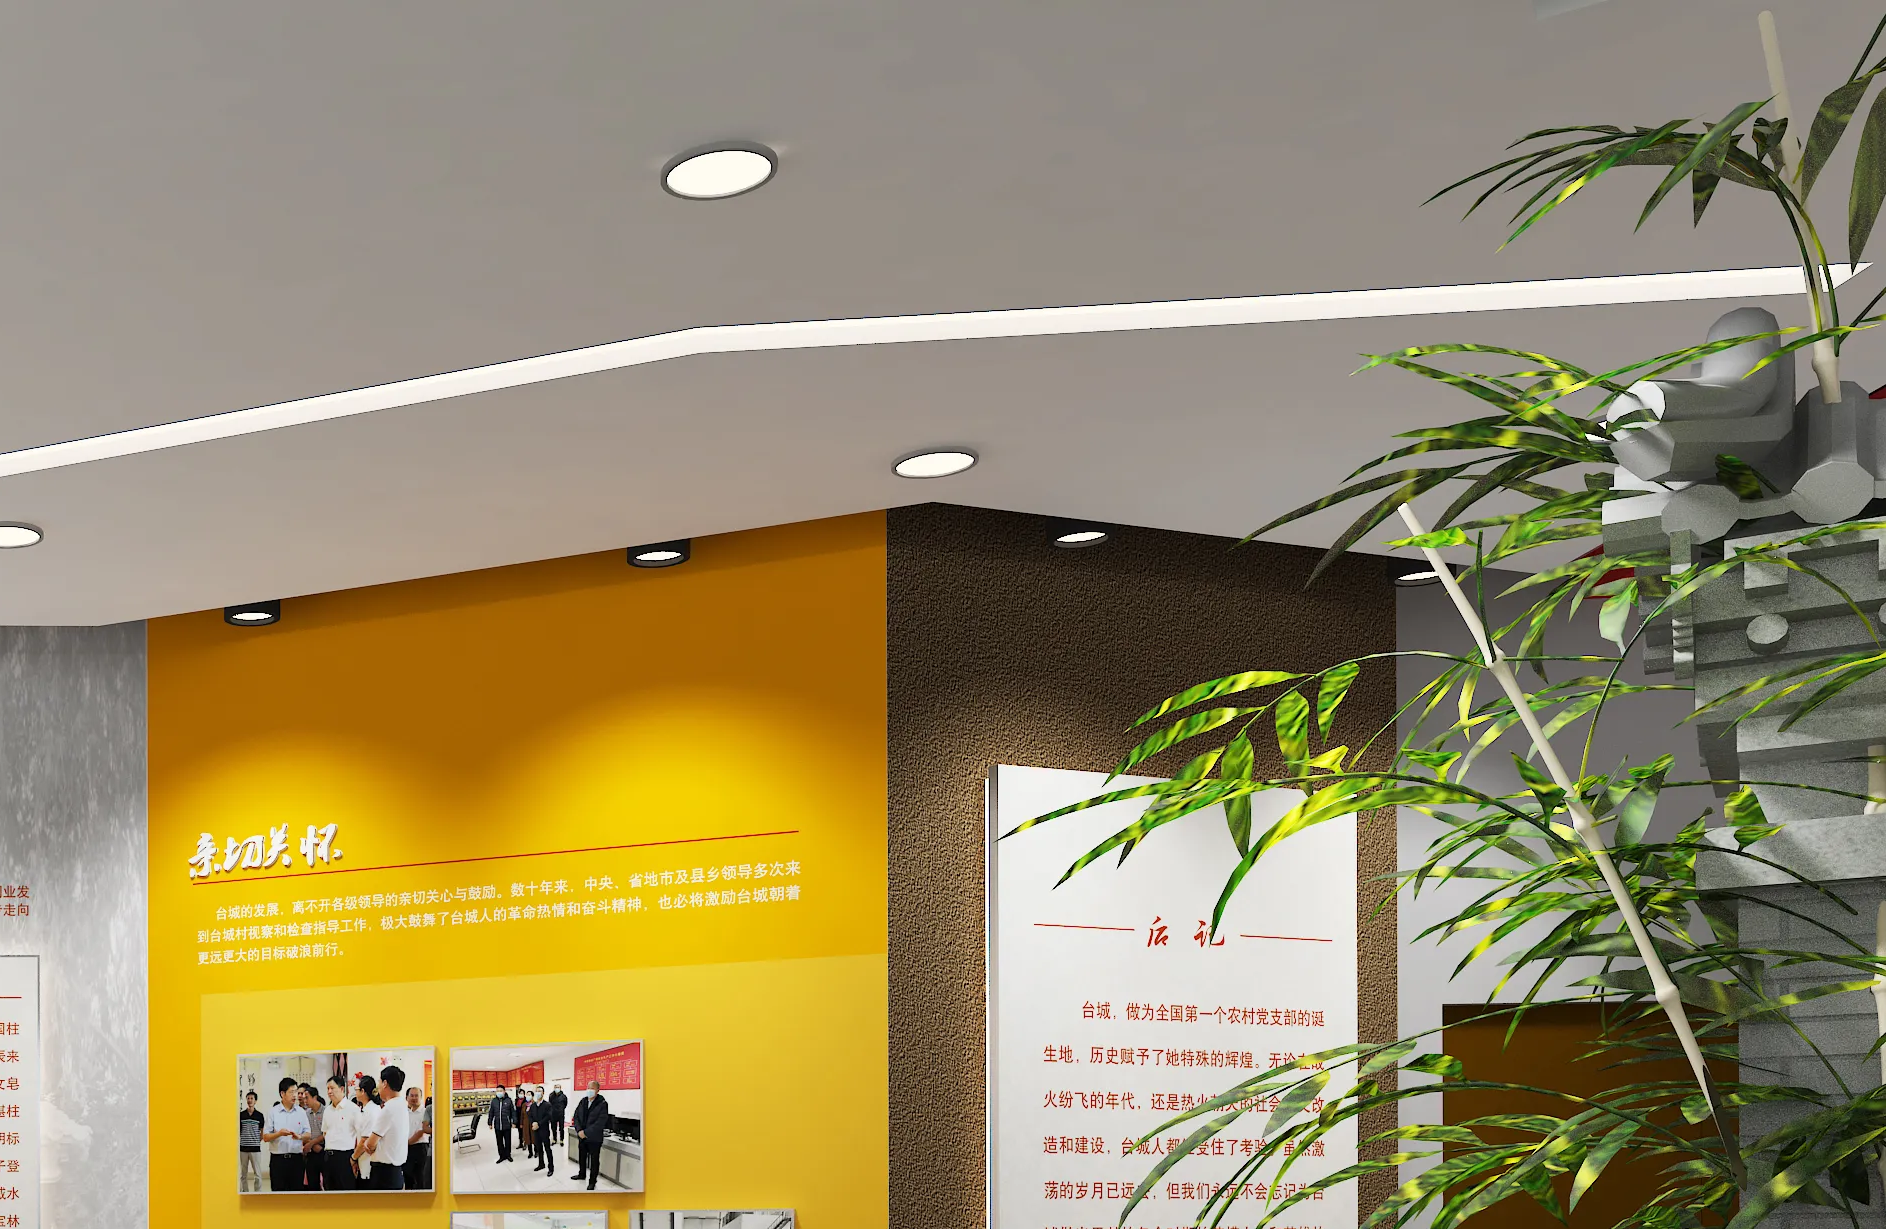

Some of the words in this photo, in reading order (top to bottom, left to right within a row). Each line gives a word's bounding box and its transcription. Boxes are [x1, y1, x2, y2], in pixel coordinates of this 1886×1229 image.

[189, 822, 343, 879] 亲切关怀
[196, 943, 346, 966] 更远更大的目标破浪前行。
[1081, 1001, 1325, 1027] 台城，做为全国第一个农村党支部的诞
